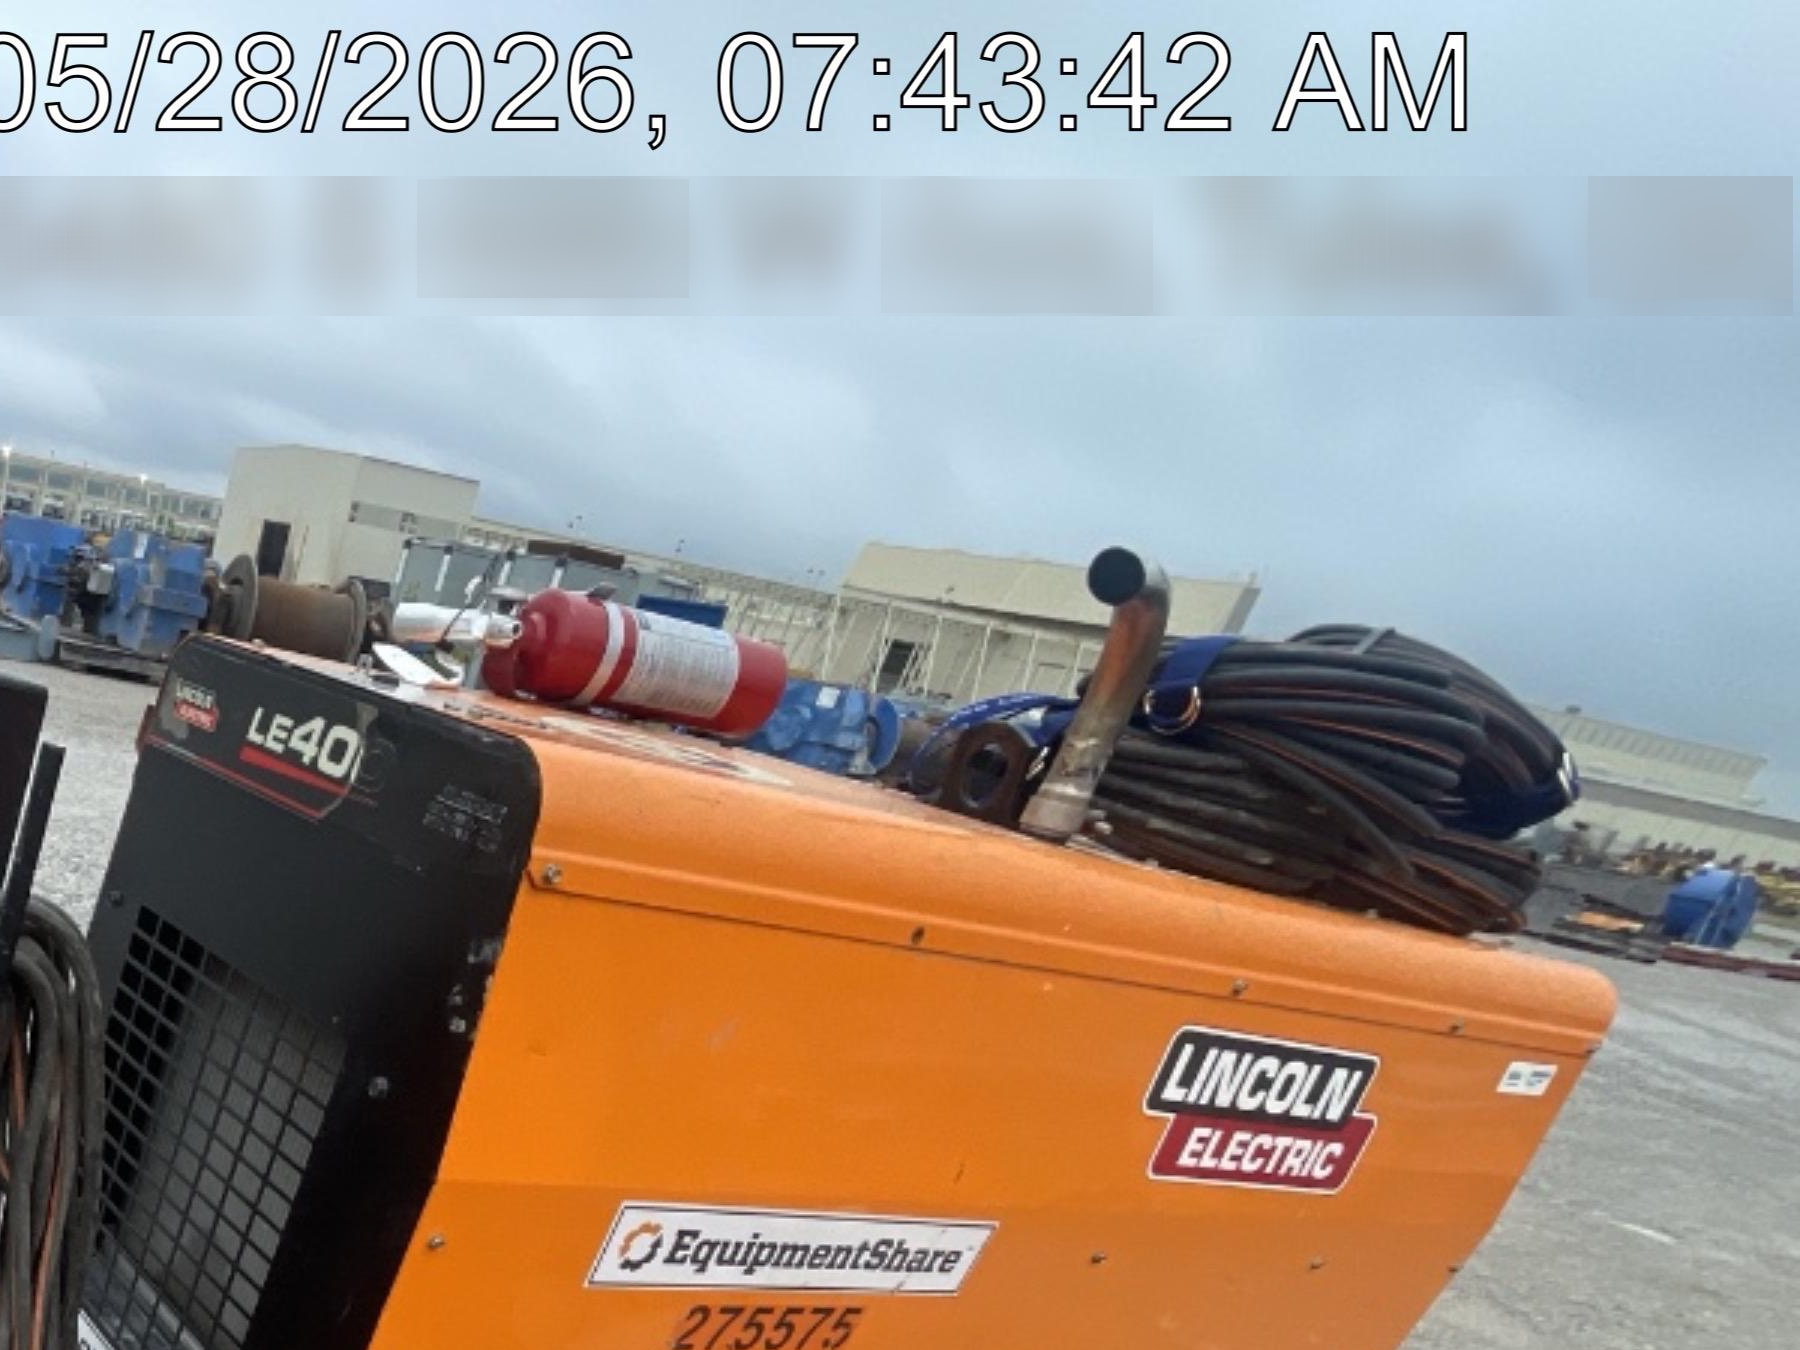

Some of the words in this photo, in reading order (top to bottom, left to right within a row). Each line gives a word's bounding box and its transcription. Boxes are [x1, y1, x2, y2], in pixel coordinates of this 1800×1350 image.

[1160, 1043, 1363, 1123] LINCOLN
[1176, 1127, 1344, 1179] ELECTRIC
[663, 1229, 964, 1275] EquipmentShare
